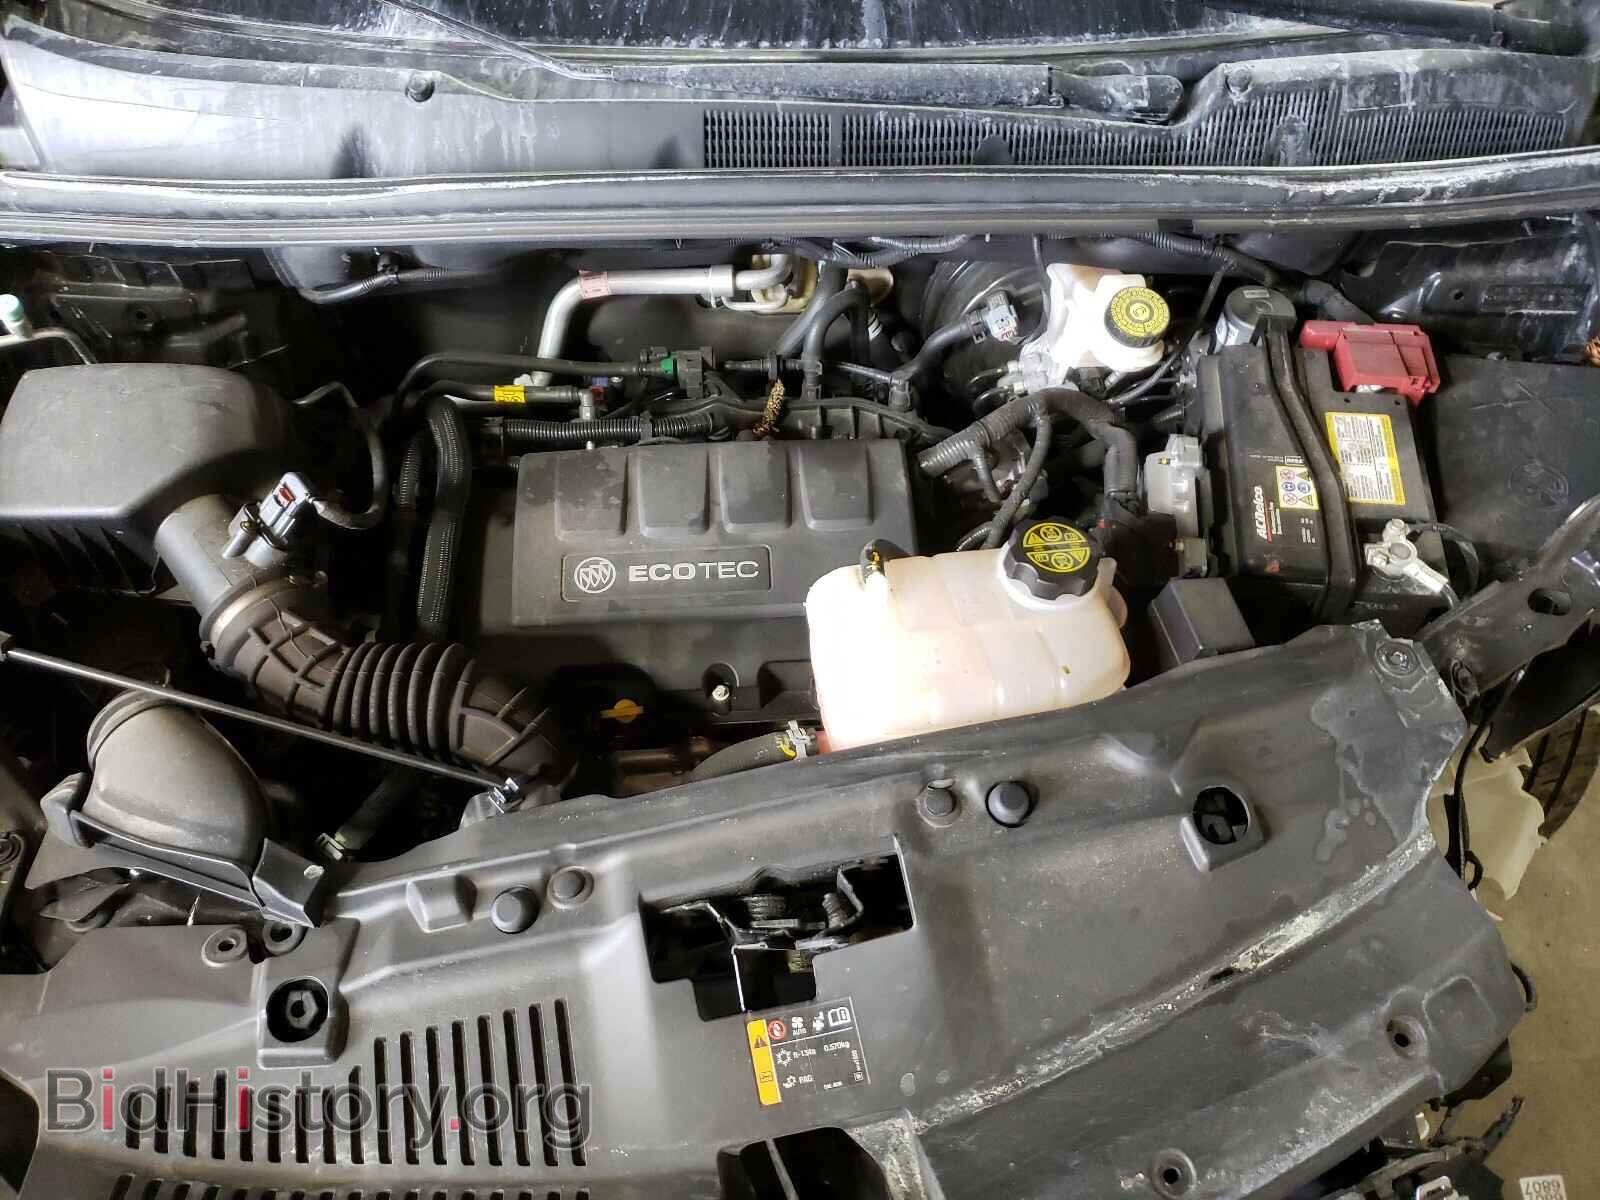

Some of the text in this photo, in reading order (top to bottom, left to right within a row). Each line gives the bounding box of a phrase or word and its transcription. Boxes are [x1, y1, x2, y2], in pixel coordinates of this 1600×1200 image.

[1252, 485, 1268, 540] ACDelco
[628, 560, 759, 582] ECOTEC
[1525, 1180, 1561, 1195] 6807
